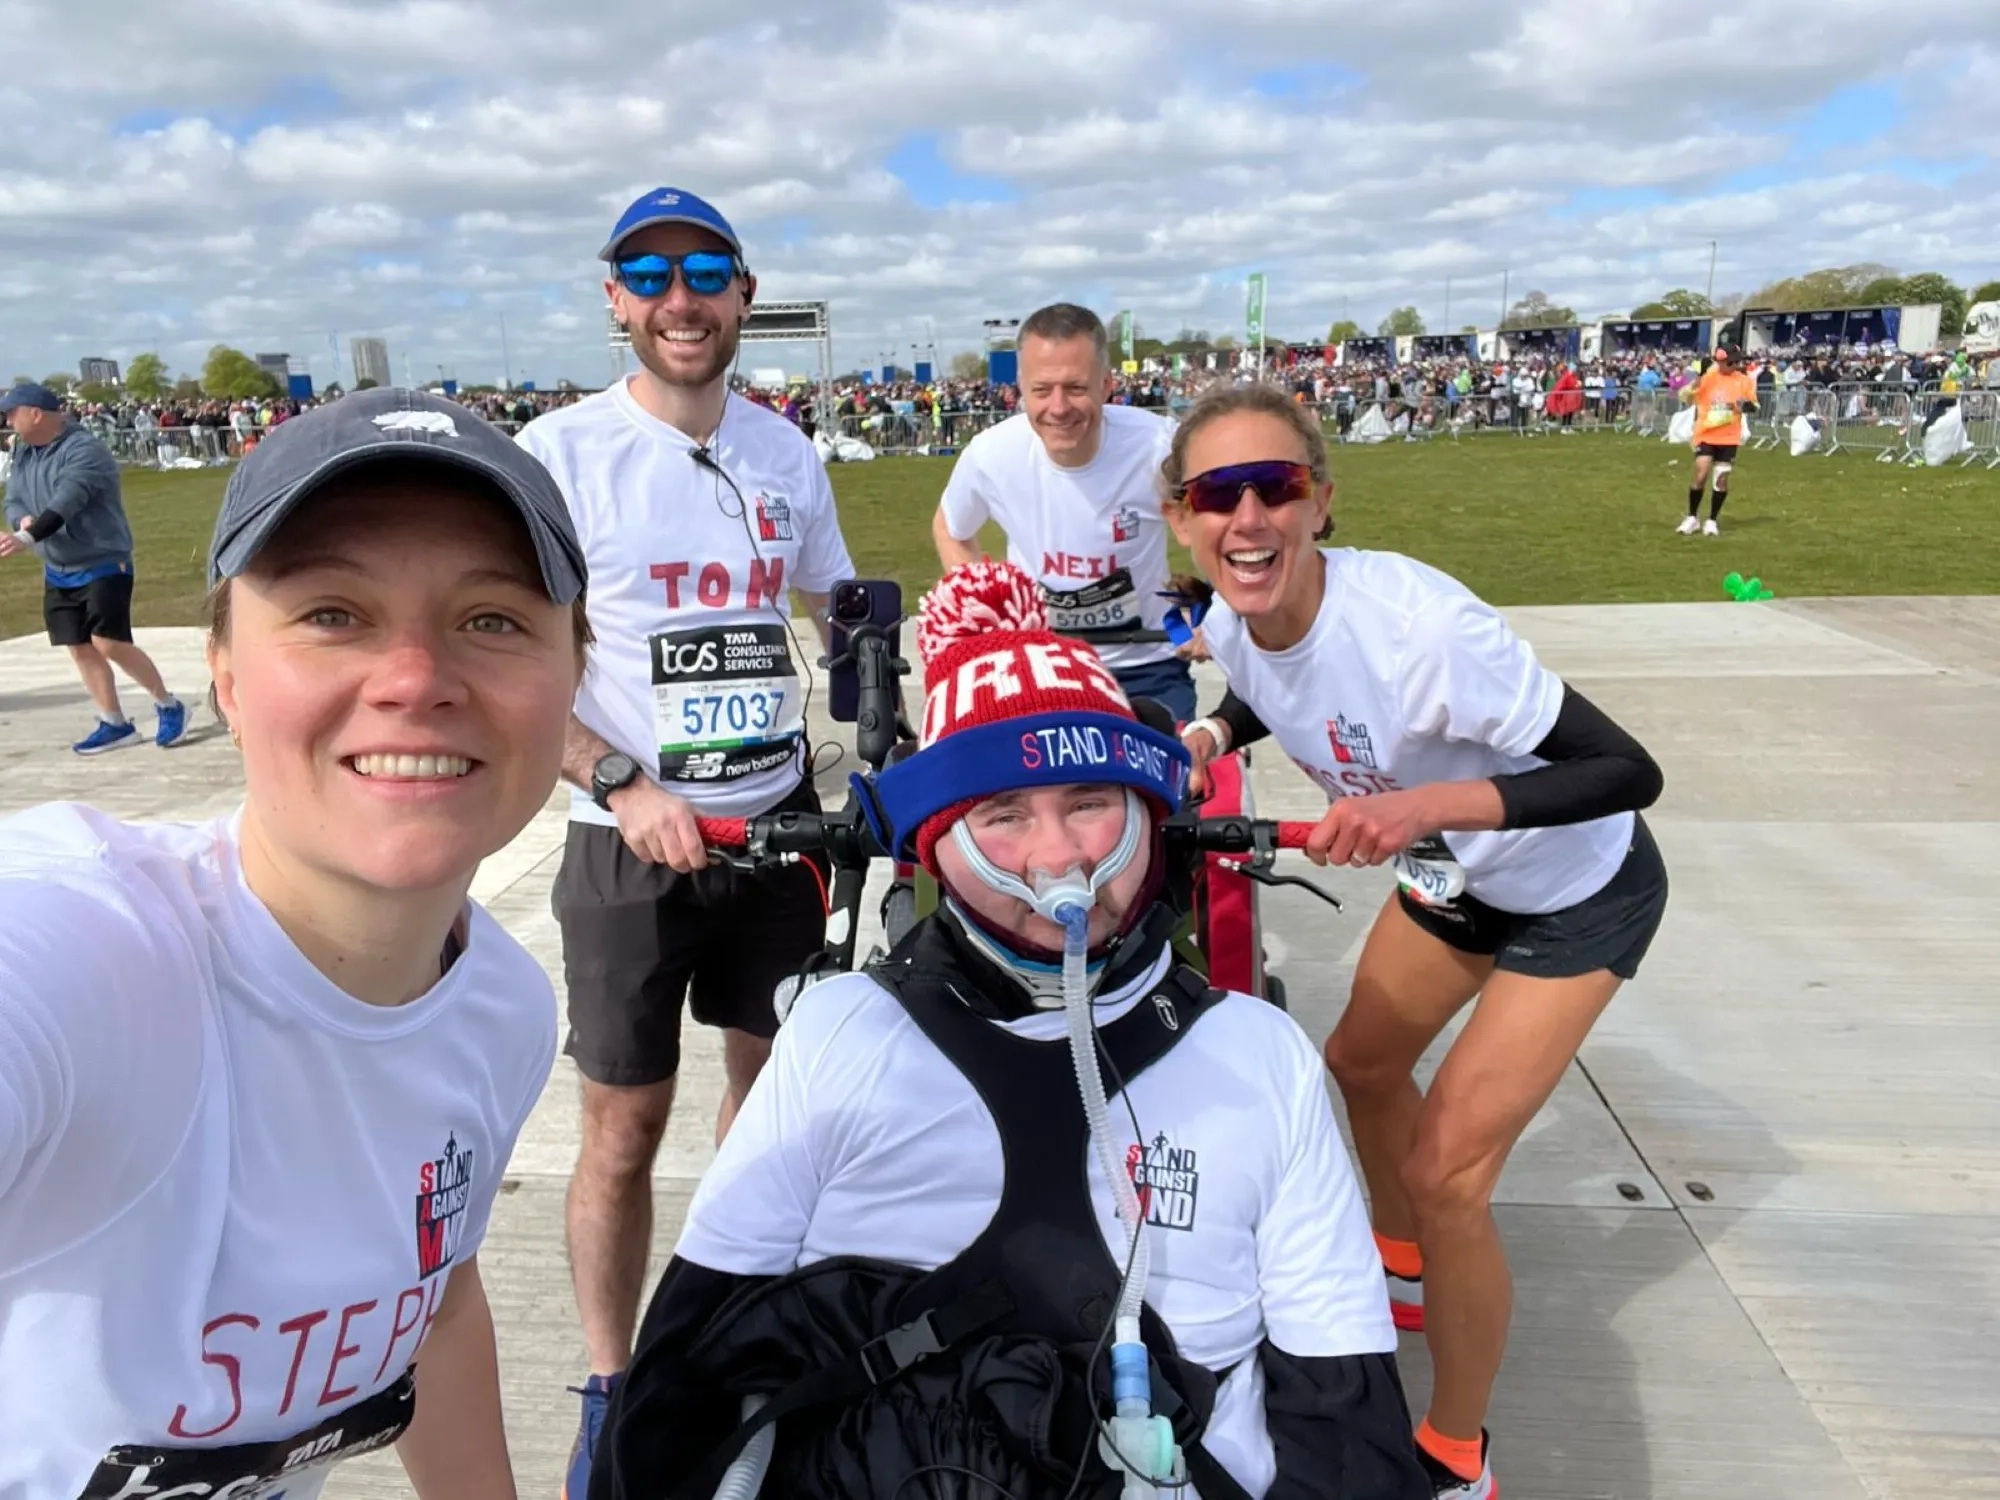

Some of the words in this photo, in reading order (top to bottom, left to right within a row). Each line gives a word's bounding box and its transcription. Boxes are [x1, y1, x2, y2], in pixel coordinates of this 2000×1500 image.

[650, 557, 784, 609] TOM
[661, 638, 718, 674] tcs
[724, 632, 757, 645] TATA
[725, 658, 773, 671] SERVICES
[683, 691, 784, 735] 57037
[726, 762, 751, 777] new
[752, 750, 790, 771] balance
[1021, 727, 1108, 769] STAND
[1126, 1132, 1196, 1172] STAND
[282, 1428, 345, 1469] TATA
